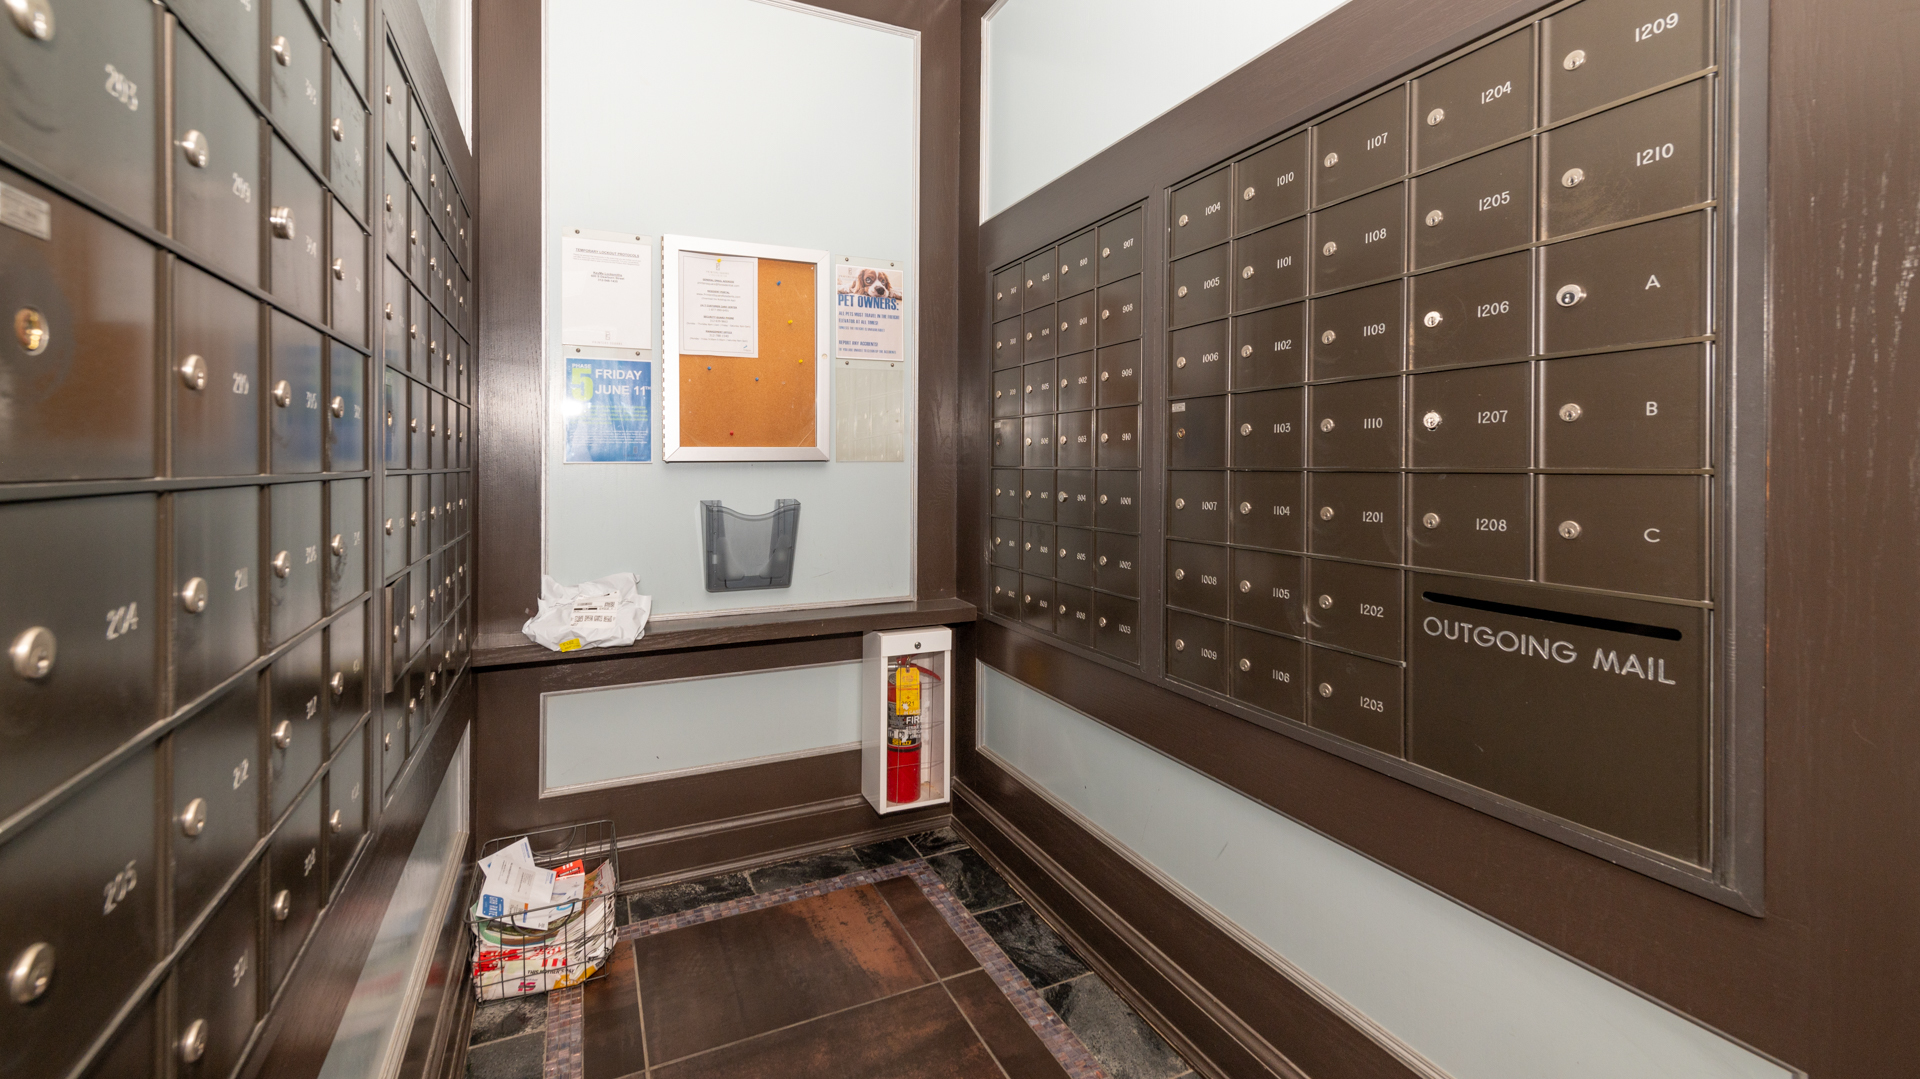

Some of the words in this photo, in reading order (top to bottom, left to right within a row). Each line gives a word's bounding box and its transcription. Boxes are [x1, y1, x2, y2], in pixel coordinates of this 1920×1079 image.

[1635, 13, 1679, 42] 1209
[1481, 81, 1512, 104] 1204
[1367, 132, 1388, 150] 1107
[1636, 143, 1674, 166] 1210
[1277, 172, 1294, 187] 1010
[1479, 191, 1510, 211] 1205
[1206, 202, 1220, 215] 1004
[1365, 228, 1386, 243] 1108
[1124, 238, 1134, 249] 907
[1277, 256, 1291, 269] 1101
[1204, 278, 1220, 289] 1005
[1645, 275, 1661, 290] A
[838, 294, 854, 307] PET
[858, 296, 899, 310] OWNERS:
[1123, 304, 1133, 313] 908
[1477, 301, 1509, 317] 1206
[1363, 323, 1385, 336] 1109
[1275, 340, 1291, 351] 1102
[1203, 352, 1218, 363] 1006
[595, 369, 642, 380] FRIDAY
[1122, 368, 1132, 377] 909
[571, 368, 593, 401] 5
[595, 384, 629, 395] JUNE
[1647, 402, 1657, 416] B
[1364, 418, 1382, 429] 1110
[1478, 410, 1508, 424] 1207
[1273, 424, 1290, 433] 1103
[1202, 502, 1217, 510] 1007
[1273, 506, 1290, 516] 1104
[1362, 512, 1383, 523] 1201
[1476, 518, 1507, 532] 1208
[1644, 529, 1660, 542] C
[1120, 561, 1131, 569] 1002
[1201, 575, 1217, 585] 1008
[1273, 588, 1290, 599] 1105
[1360, 604, 1383, 617] 1202
[106, 602, 139, 640] 204
[1119, 624, 1131, 634] 1003
[1201, 649, 1217, 660] 1009
[1423, 616, 1577, 663] OUTGOING
[1593, 648, 1676, 685] MAIL
[1272, 670, 1290, 682] 1106
[1360, 697, 1383, 712] 1203
[103, 860, 138, 915] 205
